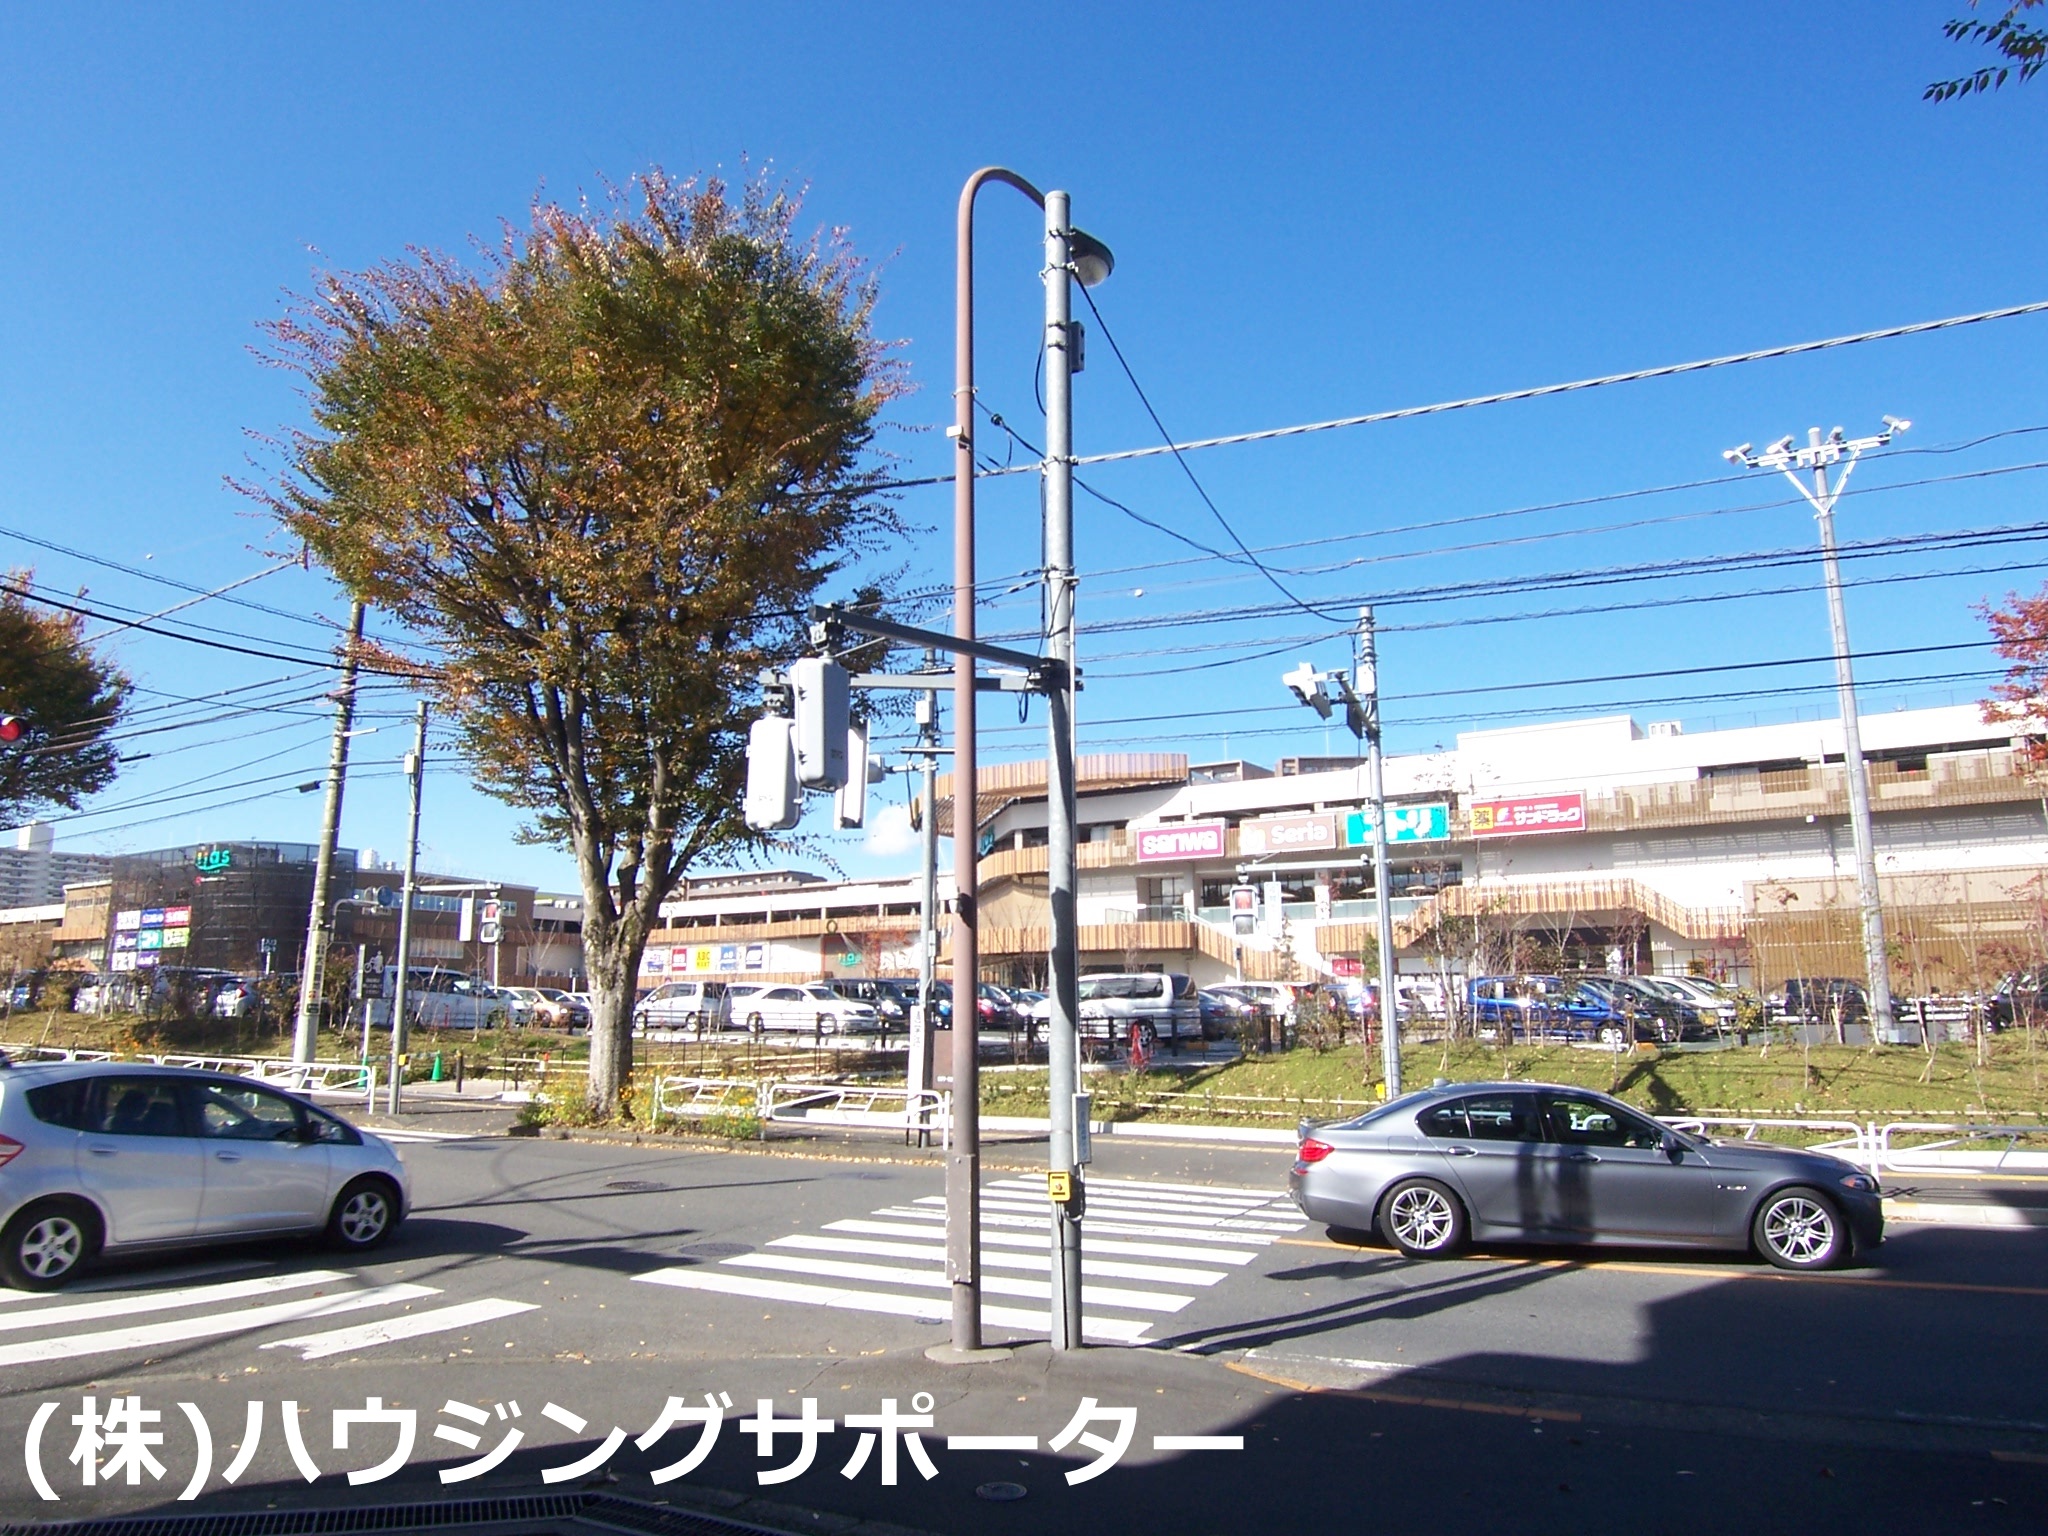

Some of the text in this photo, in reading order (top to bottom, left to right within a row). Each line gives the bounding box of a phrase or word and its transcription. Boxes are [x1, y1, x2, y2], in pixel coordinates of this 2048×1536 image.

[1142, 830, 1218, 855] sanwa
[1271, 821, 1328, 845] Seria
[696, 951, 711, 961] ABC
